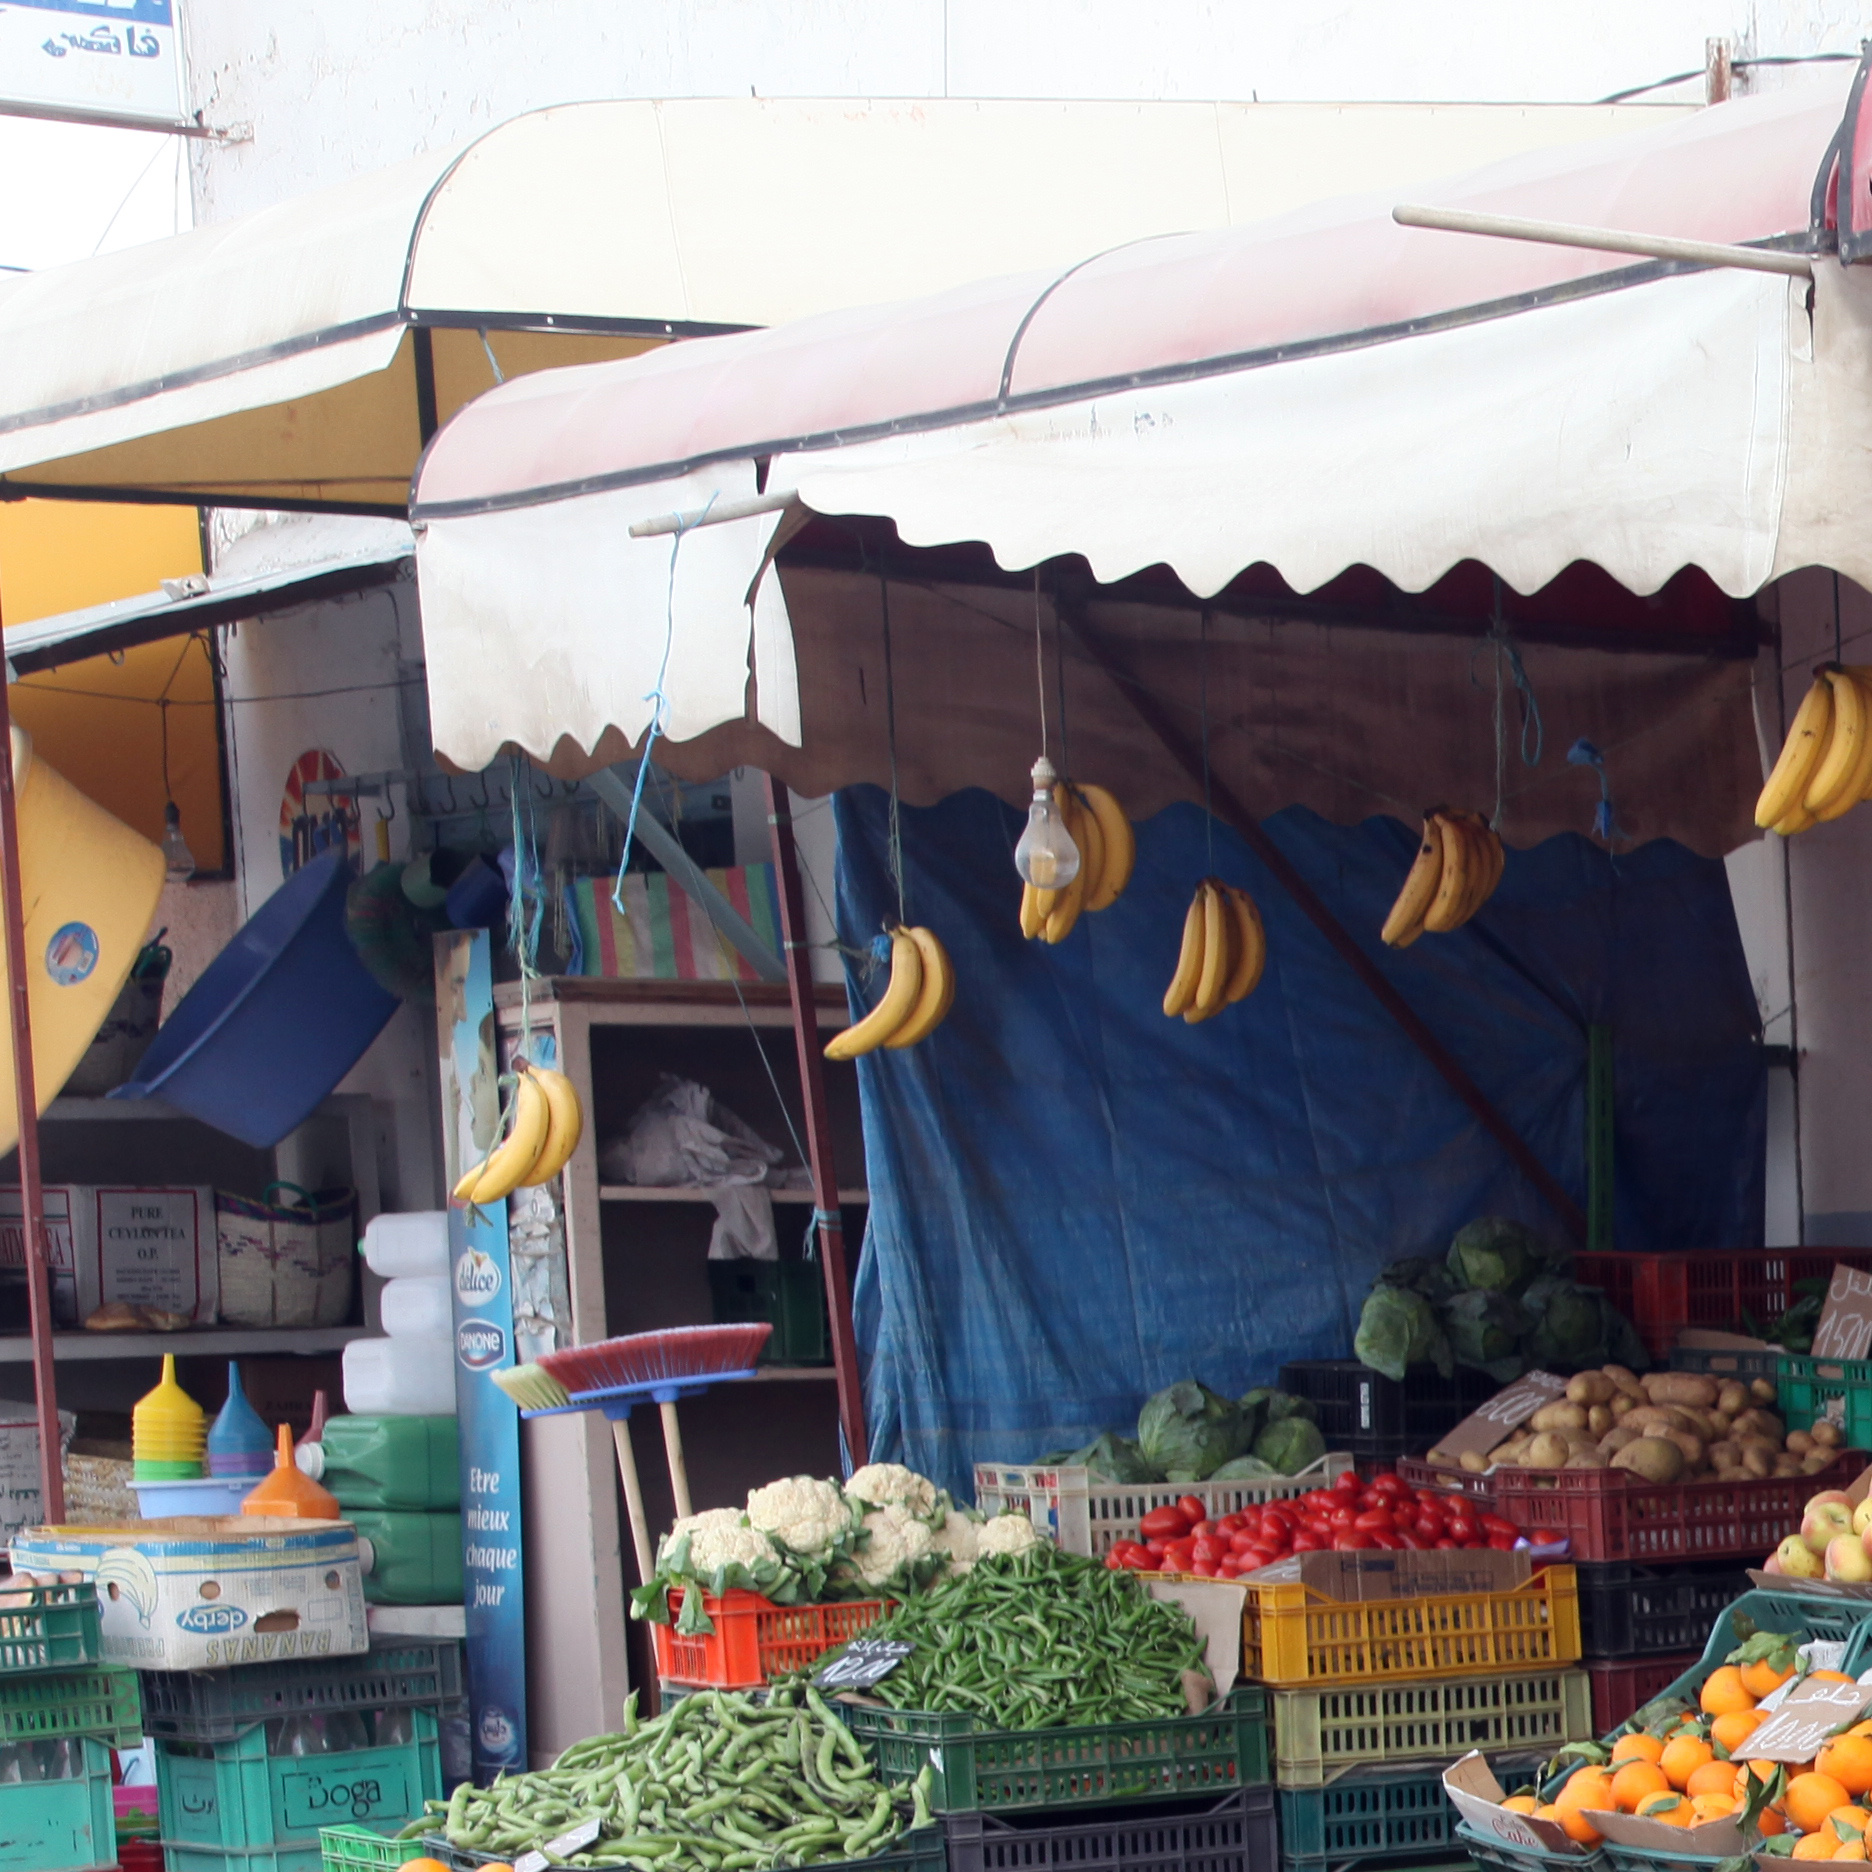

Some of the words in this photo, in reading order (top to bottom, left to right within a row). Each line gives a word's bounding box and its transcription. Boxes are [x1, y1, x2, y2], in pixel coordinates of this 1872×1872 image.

[130, 1206, 163, 1220] PURE
[163, 1228, 186, 1241] TEA
[460, 1331, 501, 1352] DANONE
[469, 1466, 500, 1495] Etre
[467, 1503, 510, 1532] mieux
[466, 1546, 518, 1574] chaque
[473, 1576, 506, 1609] jour
[180, 1607, 245, 1631] derby
[206, 1628, 332, 1664] BANANAS
